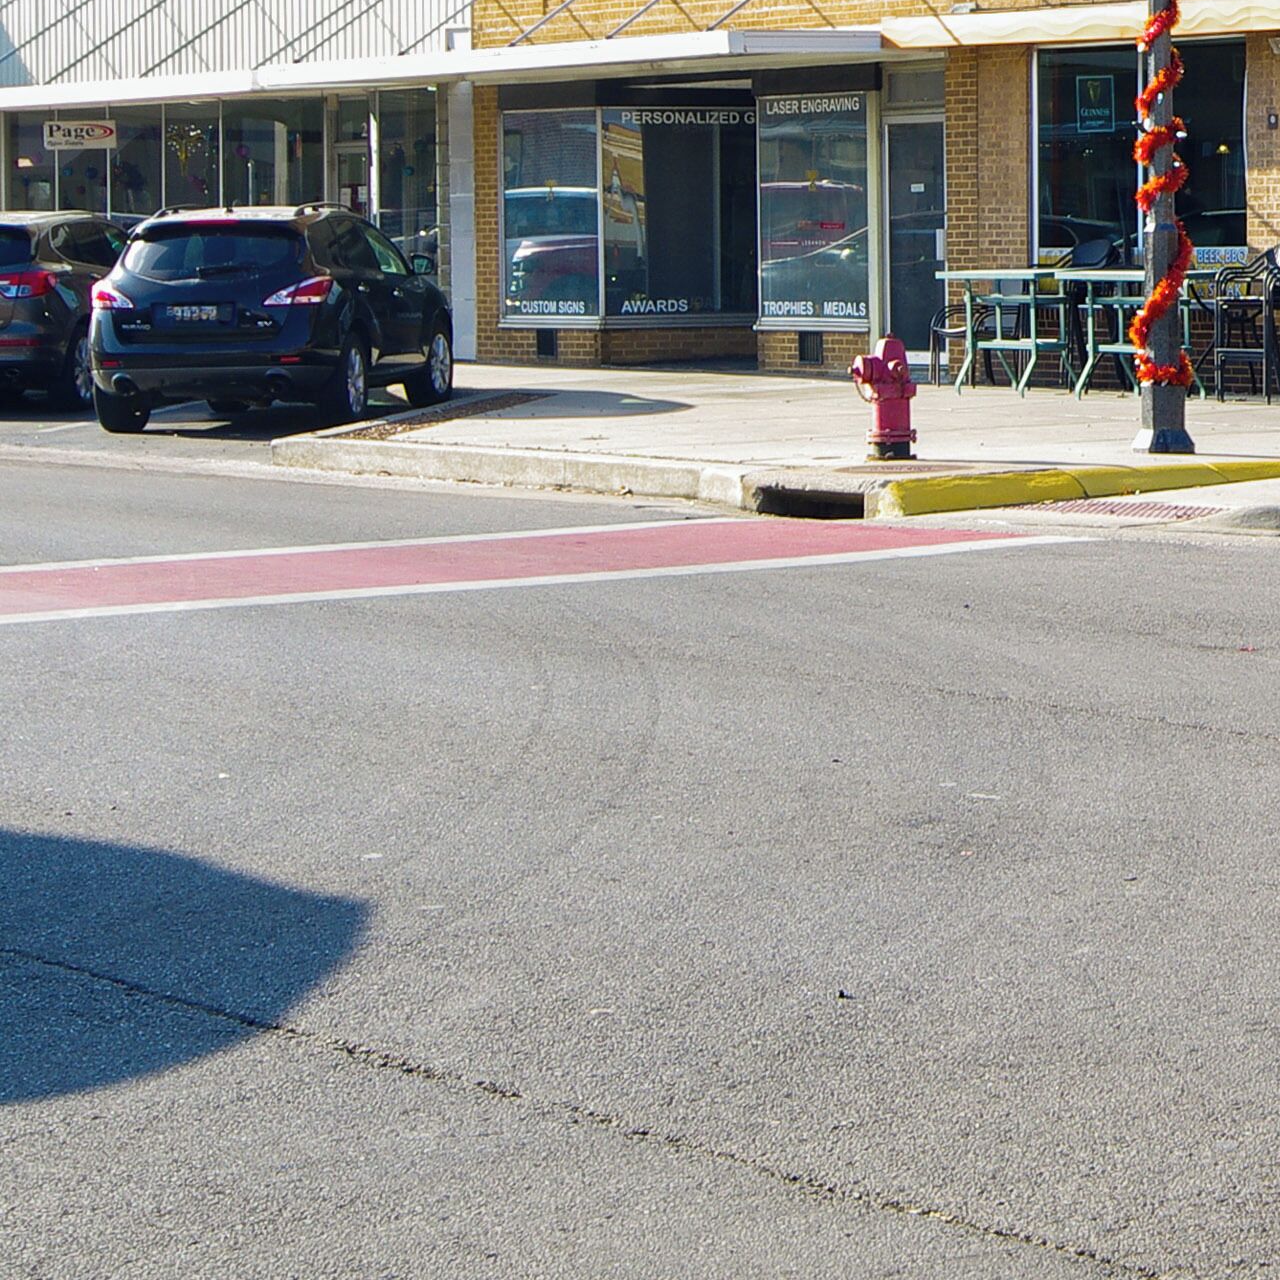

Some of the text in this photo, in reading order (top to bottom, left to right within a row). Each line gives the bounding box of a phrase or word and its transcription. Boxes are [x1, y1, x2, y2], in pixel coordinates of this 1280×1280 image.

[766, 97, 860, 115] LASER ENGRAVING
[622, 111, 740, 125] PERSONALIZED
[48, 124, 95, 140] Page
[521, 300, 585, 314] CUSTOM SIGNS
[621, 299, 688, 313] AWARDS
[763, 301, 866, 316] TROPHIES MEDALS
